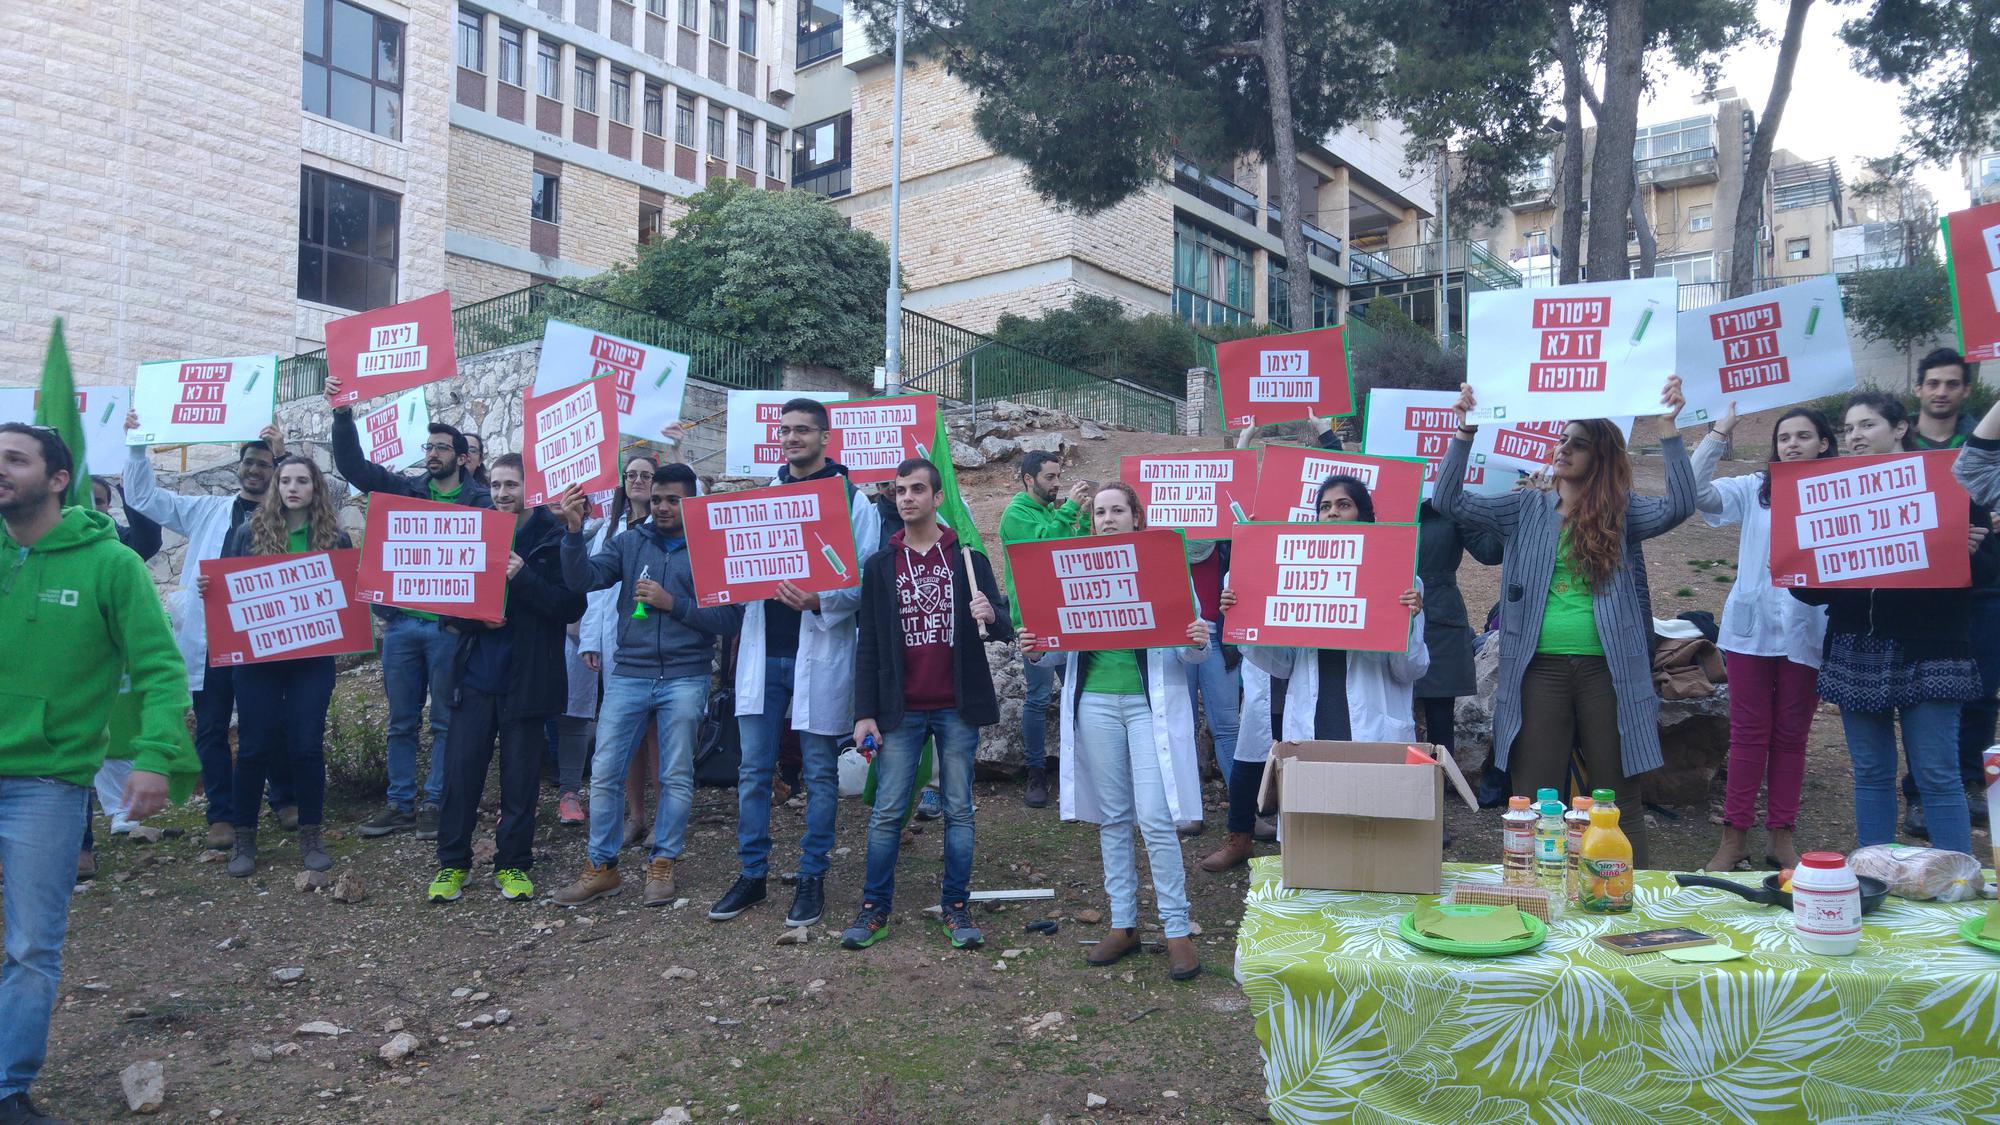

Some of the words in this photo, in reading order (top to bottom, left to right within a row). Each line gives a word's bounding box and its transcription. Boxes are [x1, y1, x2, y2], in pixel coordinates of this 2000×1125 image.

[1541, 302, 1603, 326] פיטורין
[1717, 308, 1774, 337] פיטורין
[377, 326, 411, 348] ליצמן
[1547, 332, 1570, 356] לא
[1578, 334, 1595, 356] זו
[1756, 336, 1772, 355] זו
[596, 338, 640, 367] פיטורין
[1729, 338, 1749, 361] לא
[365, 351, 421, 372] תתערב!!!
[1267, 353, 1302, 373] ליצמן
[184, 364, 227, 381] פיטורין
[617, 369, 631, 388] זו
[1538, 367, 1599, 389] תרופה!
[1727, 362, 1783, 389] תרופה!
[186, 384, 202, 400] לא
[207, 384, 220, 400] זו
[1257, 381, 1313, 398] תתערב!!!
[178, 406, 221, 422] תרופה!
[565, 390, 592, 421] הבראת
[370, 407, 396, 430] פיטורין
[540, 407, 564, 434] הדסה
[835, 410, 876, 426] ההרדמה
[881, 408, 912, 424] נגמרה
[374, 429, 385, 446] לא
[387, 424, 395, 440] זו
[570, 430, 582, 449] על
[584, 420, 597, 444] לא
[846, 432, 870, 446] הזמן
[875, 430, 898, 444] הגיע
[542, 437, 568, 464] חשבון
[1423, 434, 1441, 453] לא
[1500, 434, 1546, 460] מיקוח!
[844, 449, 901, 466] להתעורר!!!
[548, 452, 597, 492] הסטודנטים!
[1144, 464, 1189, 479] ההרדמה
[1195, 464, 1228, 479] נגמרה
[1858, 464, 1917, 495] הבראת
[1155, 486, 1181, 502] הזמן
[1186, 486, 1212, 501] הגיע
[1806, 477, 1851, 505] הדסה
[714, 503, 768, 526] ההרדמה
[774, 500, 814, 520] נגמרה
[1151, 507, 1214, 522] להתעורר!!!
[1868, 508, 1891, 531] על
[1899, 501, 1921, 526] לא
[394, 517, 428, 535] הדסה
[434, 517, 476, 535] הבראת
[1810, 513, 1861, 542] חשבון
[730, 532, 761, 552] הזמן
[768, 528, 799, 548] הגיע
[394, 547, 431, 567] חשבון
[437, 547, 453, 566] על
[459, 547, 476, 566] לא
[1283, 539, 1356, 560] רוטשטיין!
[1823, 541, 1920, 575] הסטודנטים!
[730, 554, 804, 578] להתעורר!!!
[1060, 550, 1131, 575] רוטשטיין!
[233, 571, 274, 595] הדסה
[278, 561, 327, 585] הבראת
[1284, 569, 1329, 591] לפגוע
[1337, 571, 1351, 591] די
[398, 578, 469, 597] הסטודנטים!
[901, 589, 912, 604] 8
[1070, 579, 1110, 601] לפגוע
[1119, 578, 1133, 597] די
[290, 594, 310, 613] על
[315, 588, 333, 608] לא
[241, 600, 286, 625] חשבון
[1066, 607, 1148, 630] בסטודנטים!
[1273, 602, 1358, 624] בסטודנטים!
[256, 618, 337, 651] הסטודנטים!
[906, 630, 937, 647] GIVE
